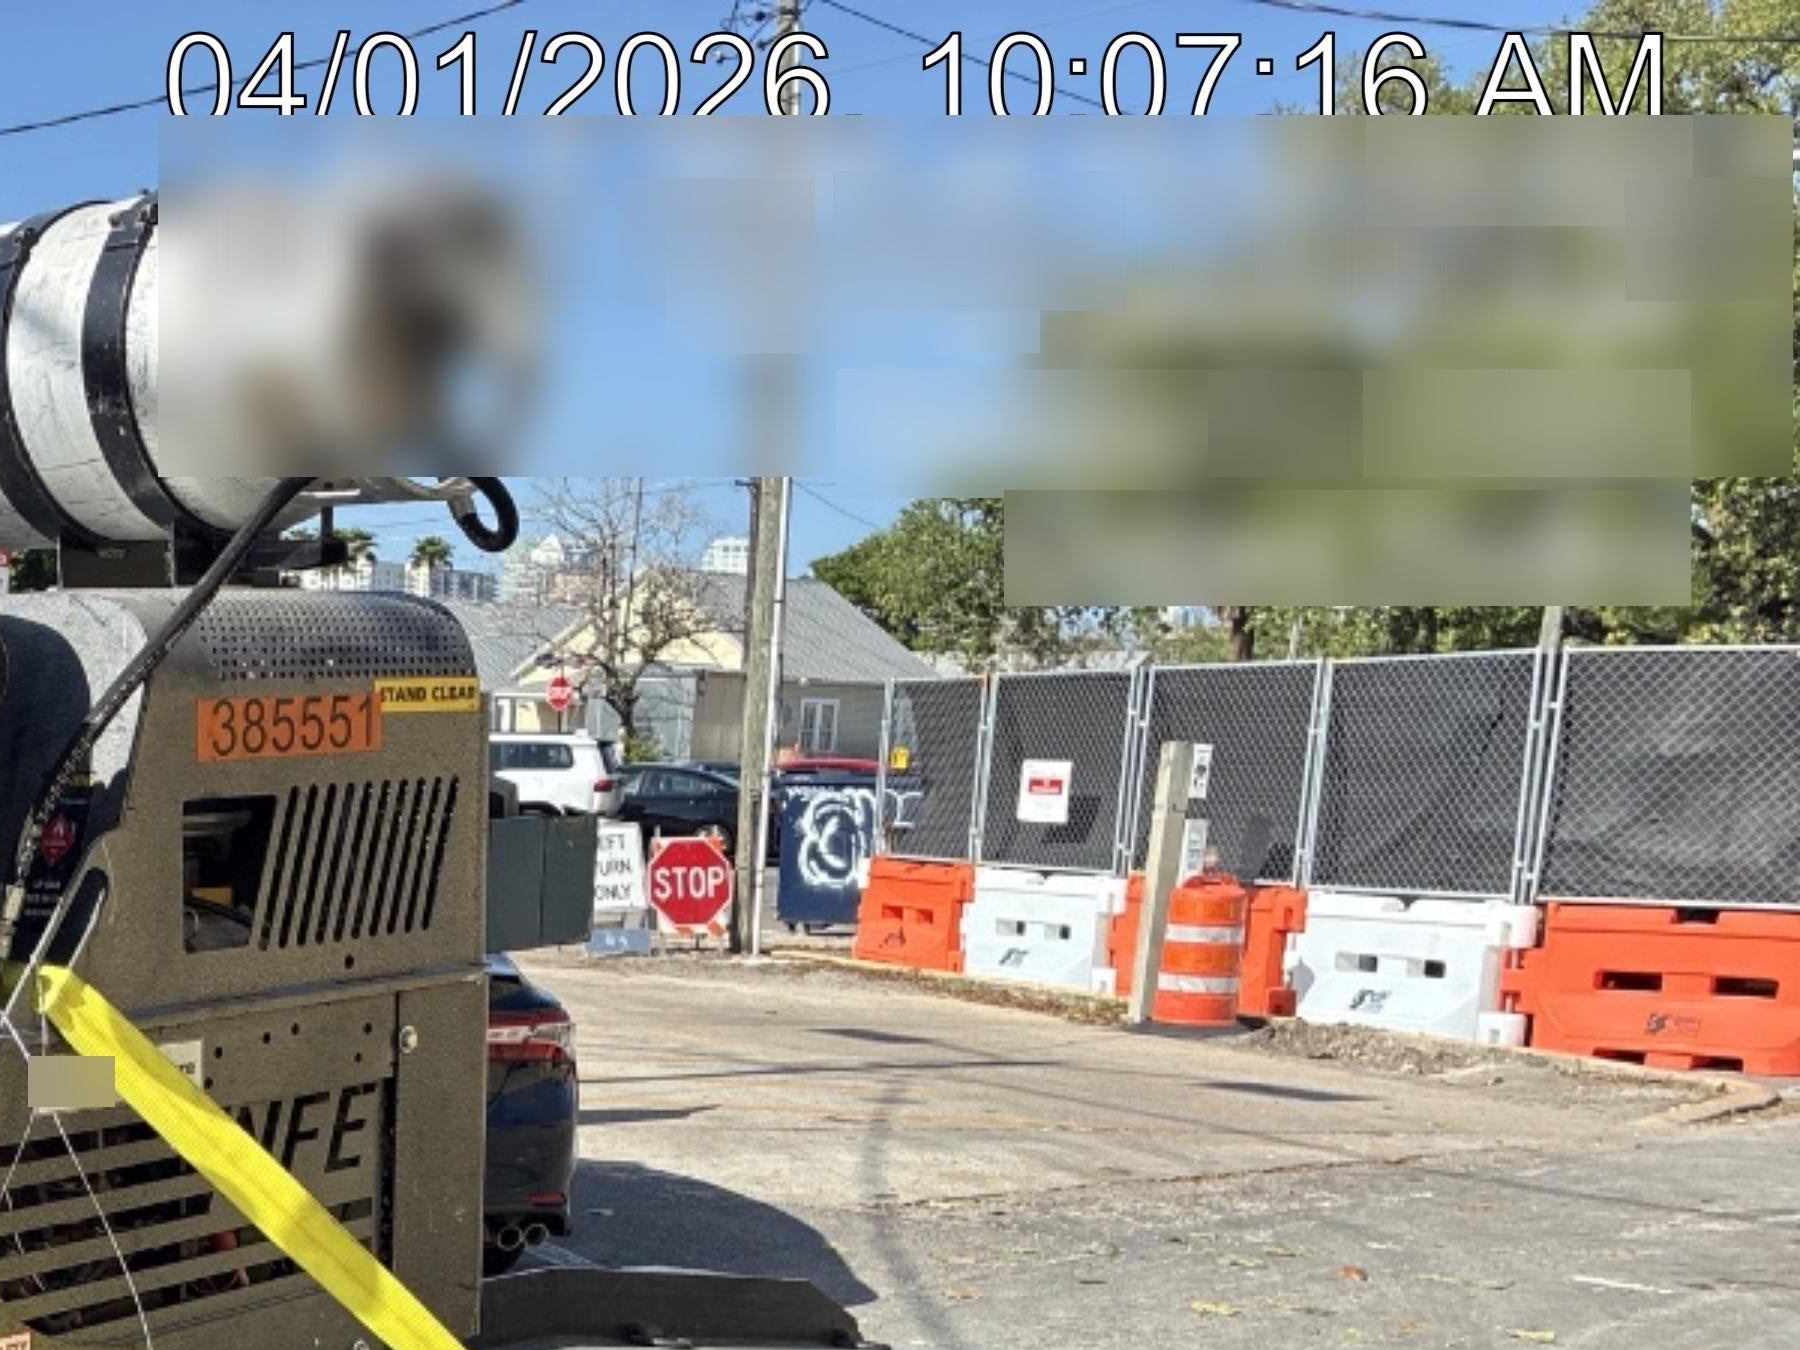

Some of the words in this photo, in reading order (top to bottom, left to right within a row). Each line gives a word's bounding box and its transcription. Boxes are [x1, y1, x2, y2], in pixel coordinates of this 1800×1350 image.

[380, 685, 428, 703] STAND
[431, 684, 477, 703] CLEAR
[211, 694, 373, 757] 385551
[598, 858, 632, 877] URN
[654, 866, 725, 900] STOP
